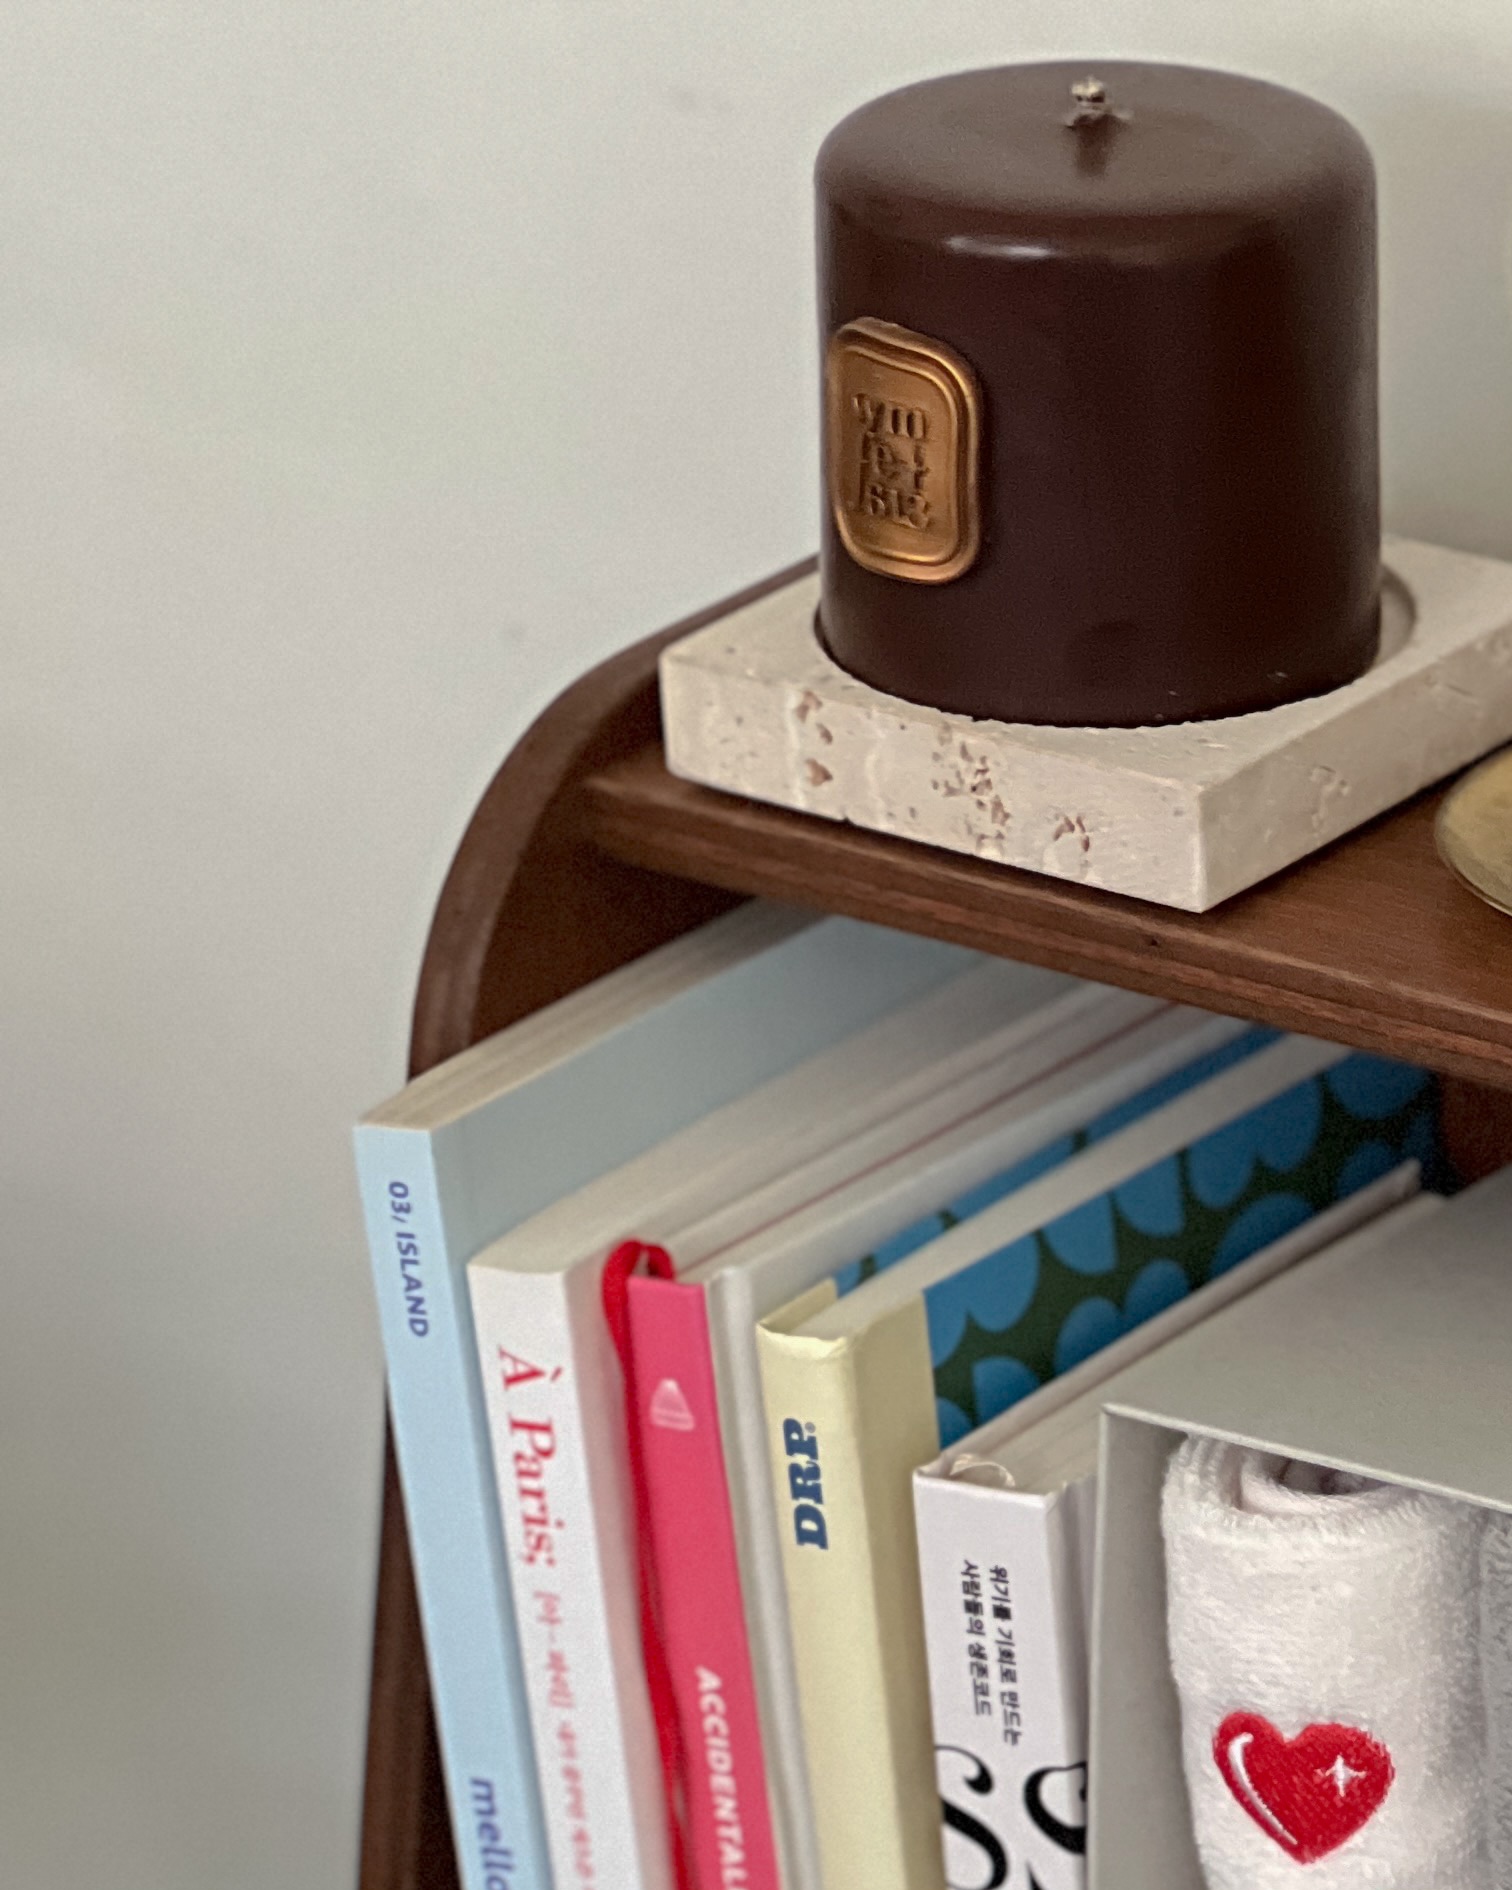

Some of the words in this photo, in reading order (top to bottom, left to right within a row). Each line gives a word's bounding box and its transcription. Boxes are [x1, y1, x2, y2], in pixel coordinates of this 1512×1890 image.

[396, 1229, 429, 1338] ISLAND
[497, 1344, 564, 1392] À
[960, 1558, 986, 1636] 사람들의
[989, 1564, 1012, 1622] 위기를
[967, 1642, 993, 1717] 생존코드
[995, 1626, 1018, 1684] 기회로
[999, 1690, 1023, 1747] 만드는
